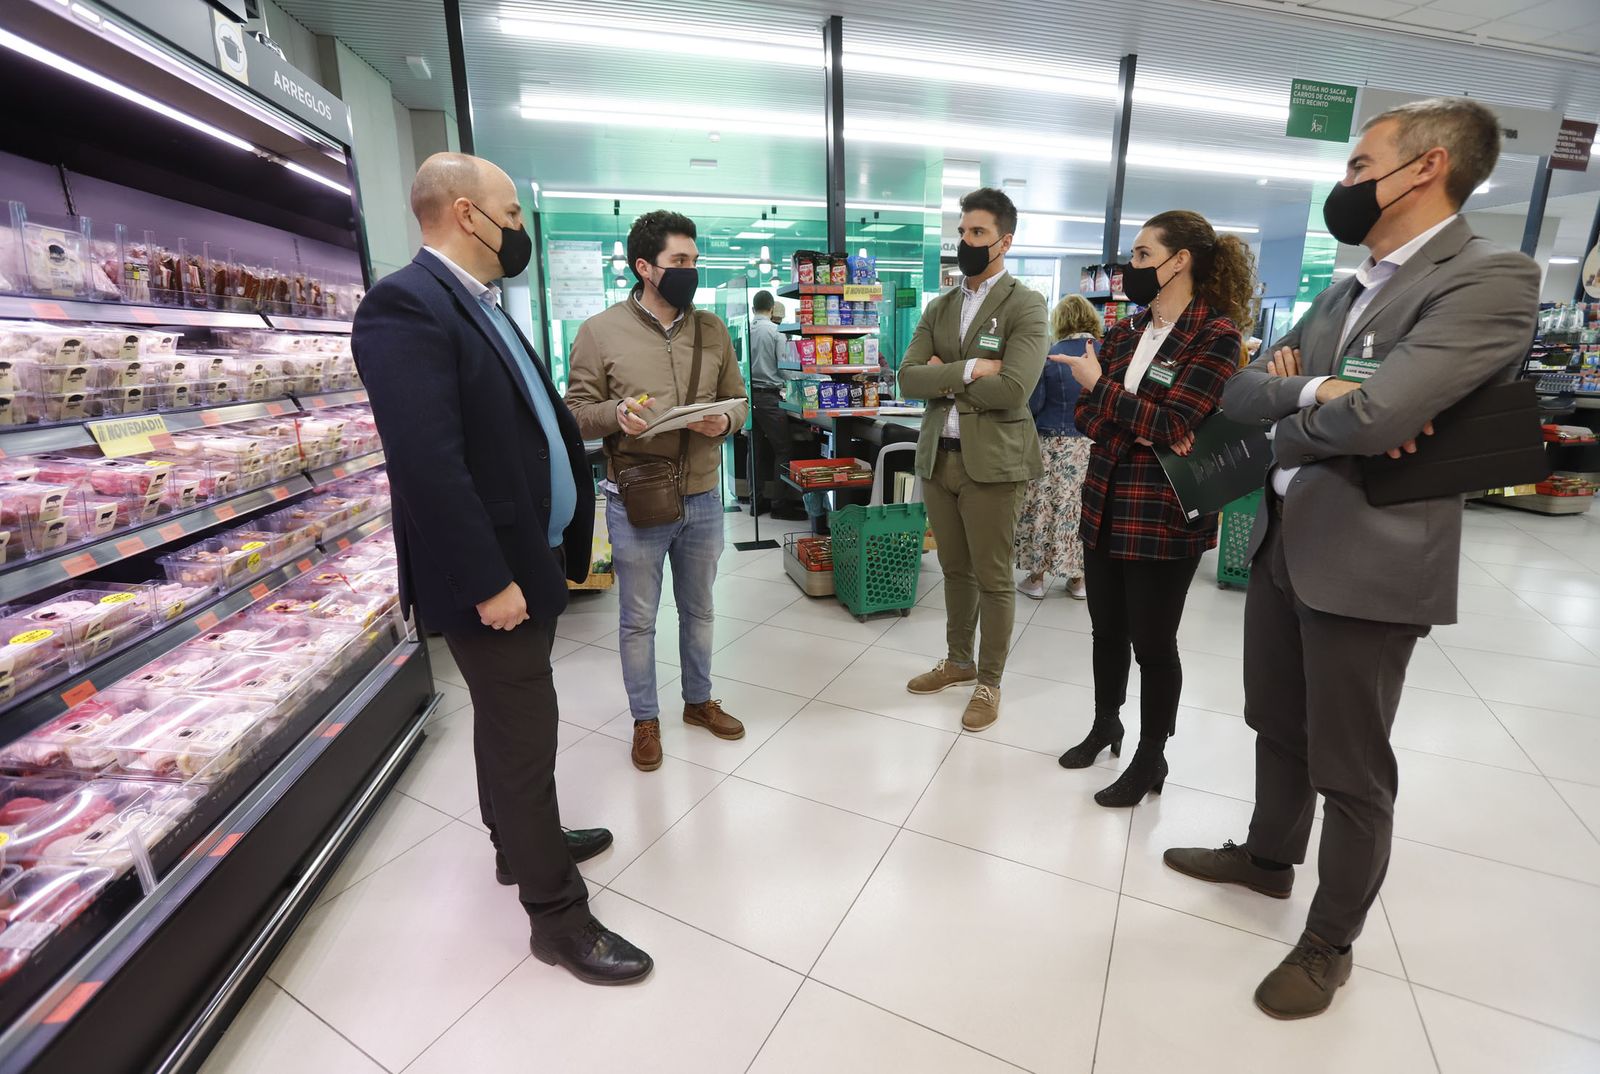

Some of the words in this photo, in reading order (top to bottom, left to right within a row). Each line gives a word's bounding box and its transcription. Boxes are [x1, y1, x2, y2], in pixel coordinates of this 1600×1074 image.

[1302, 84, 1320, 92] RUEGA
[274, 70, 332, 121] ARREGLOS
[1323, 94, 1345, 102] COMPRA
[1306, 99, 1329, 107] RECINTO
